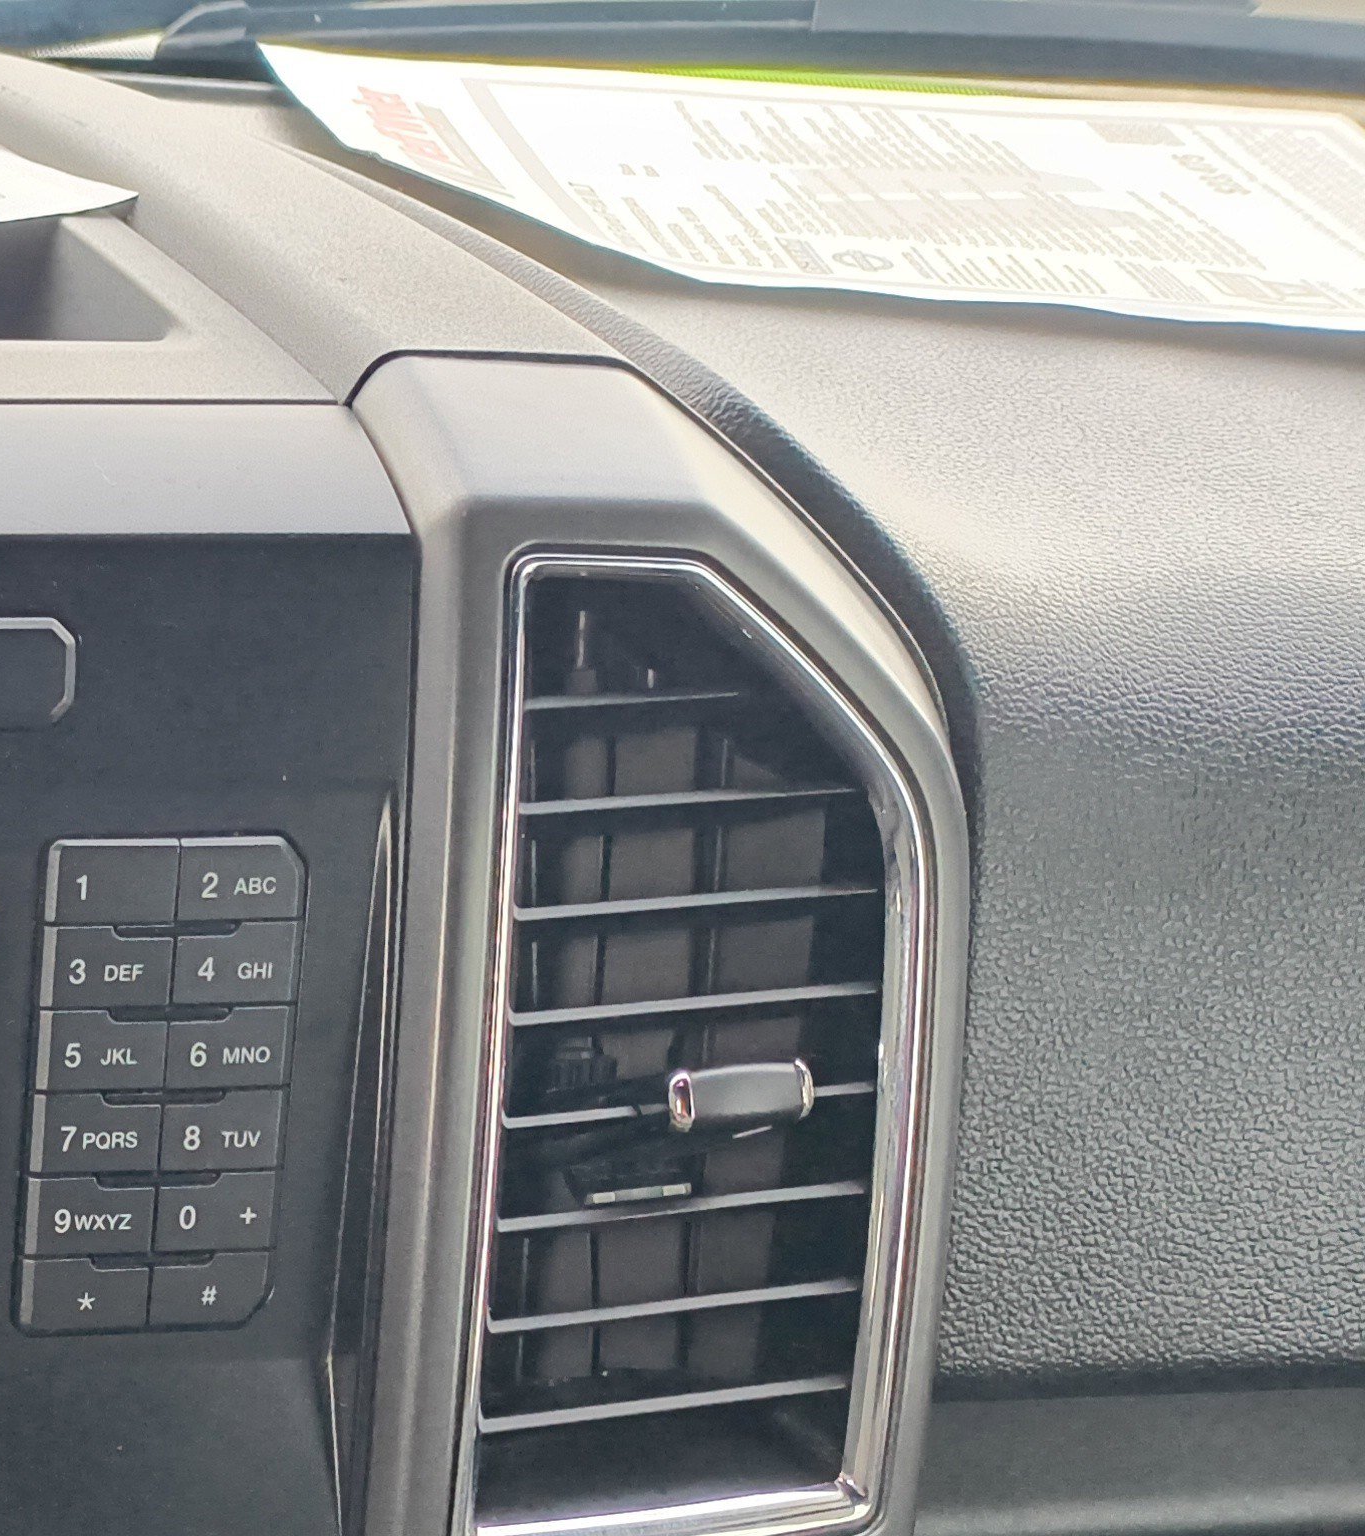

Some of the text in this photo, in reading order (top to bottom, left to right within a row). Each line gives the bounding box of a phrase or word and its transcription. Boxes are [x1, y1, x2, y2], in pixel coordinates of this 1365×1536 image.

[76, 874, 87, 900] 1
[202, 872, 277, 899] 2 ABC
[69, 958, 144, 984] 3 DEF
[198, 956, 273, 981] 4 GHI
[64, 1042, 138, 1067] 5 JKL
[189, 1042, 271, 1067] 6 MNO
[60, 1126, 138, 1152] 7 PQRS
[183, 1125, 261, 1150] 8 TUV
[54, 1208, 132, 1234] 9 WXYZ
[179, 1205, 197, 1230] 0
